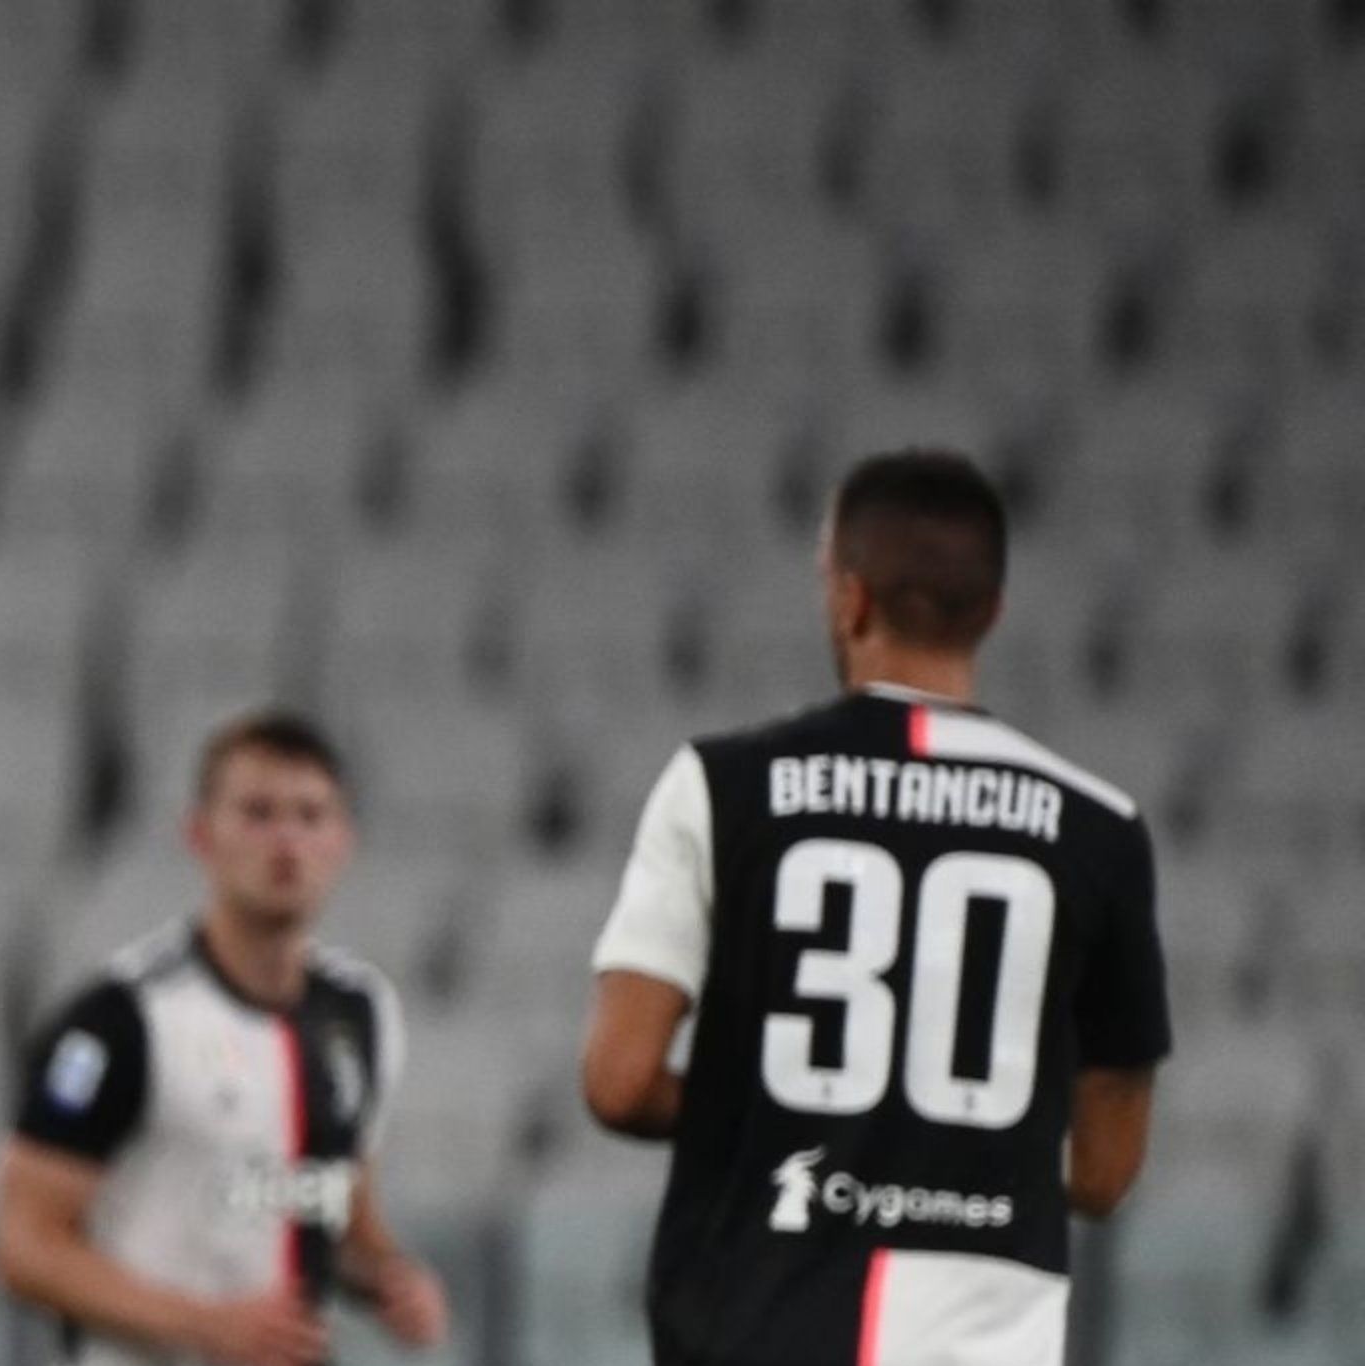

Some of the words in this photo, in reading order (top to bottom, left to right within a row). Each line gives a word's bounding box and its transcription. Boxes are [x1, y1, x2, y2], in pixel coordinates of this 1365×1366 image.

[770, 753, 1062, 842] BENTANCUR
[762, 837, 1056, 1130] 30
[821, 1170, 1013, 1228] Cygames
